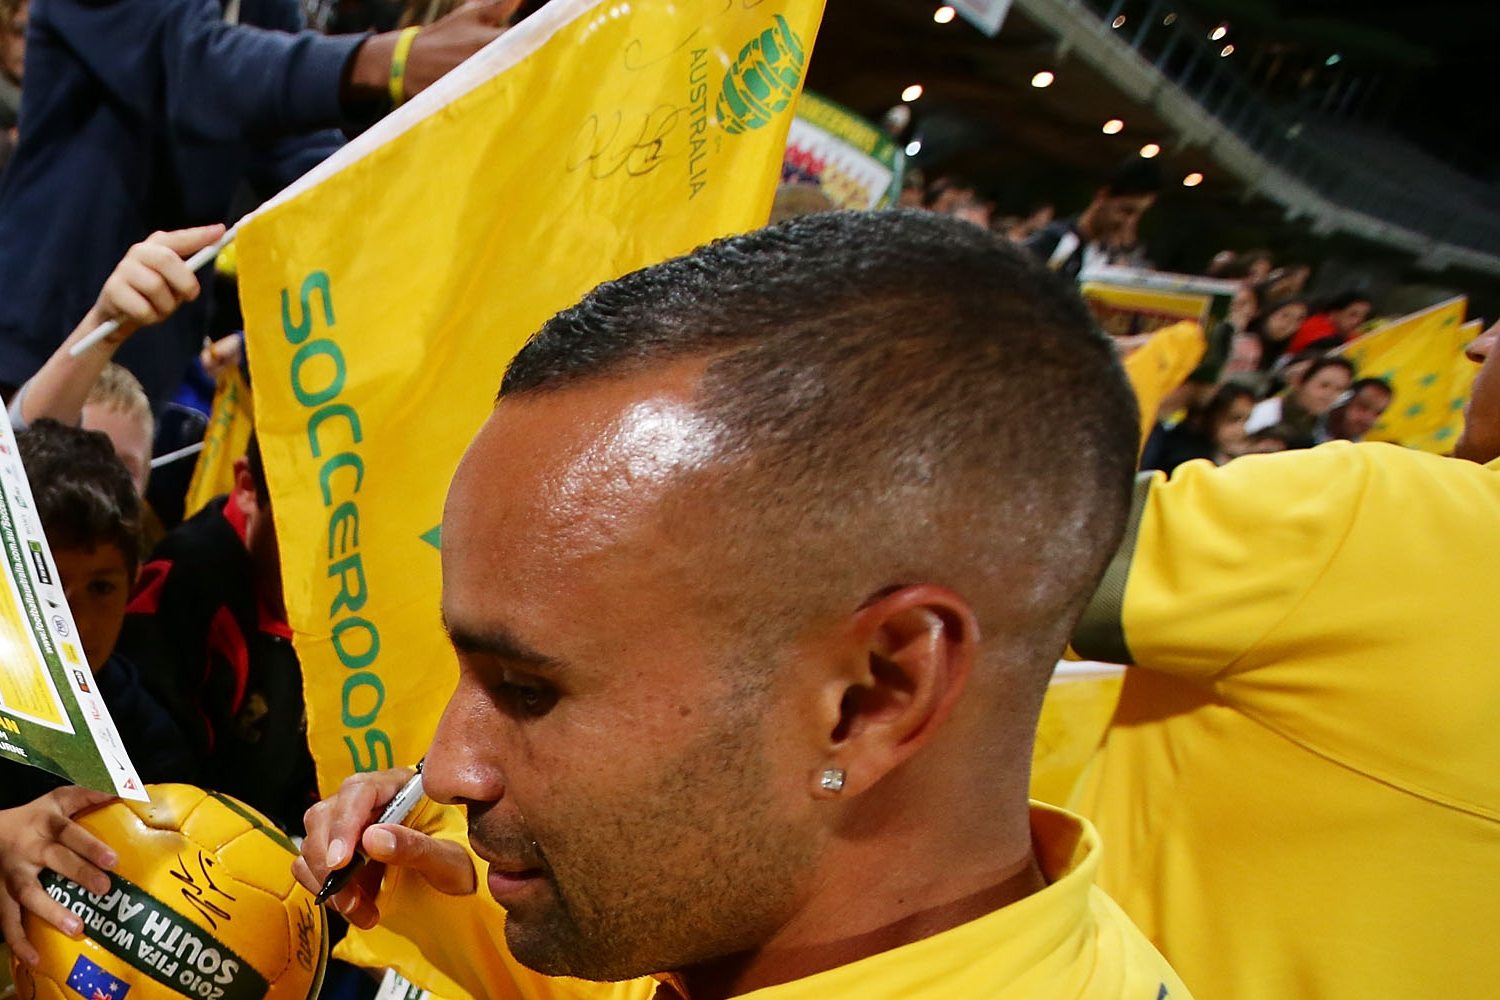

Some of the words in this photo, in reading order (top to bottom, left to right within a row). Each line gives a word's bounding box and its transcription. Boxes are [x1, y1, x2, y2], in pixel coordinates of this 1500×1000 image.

[688, 47, 709, 200] AUSTRALIA
[281, 270, 395, 773] SOCCEROOS
[70, 899, 135, 951] WORLD
[137, 940, 180, 977] FIFA
[141, 910, 240, 985] SOUTH
